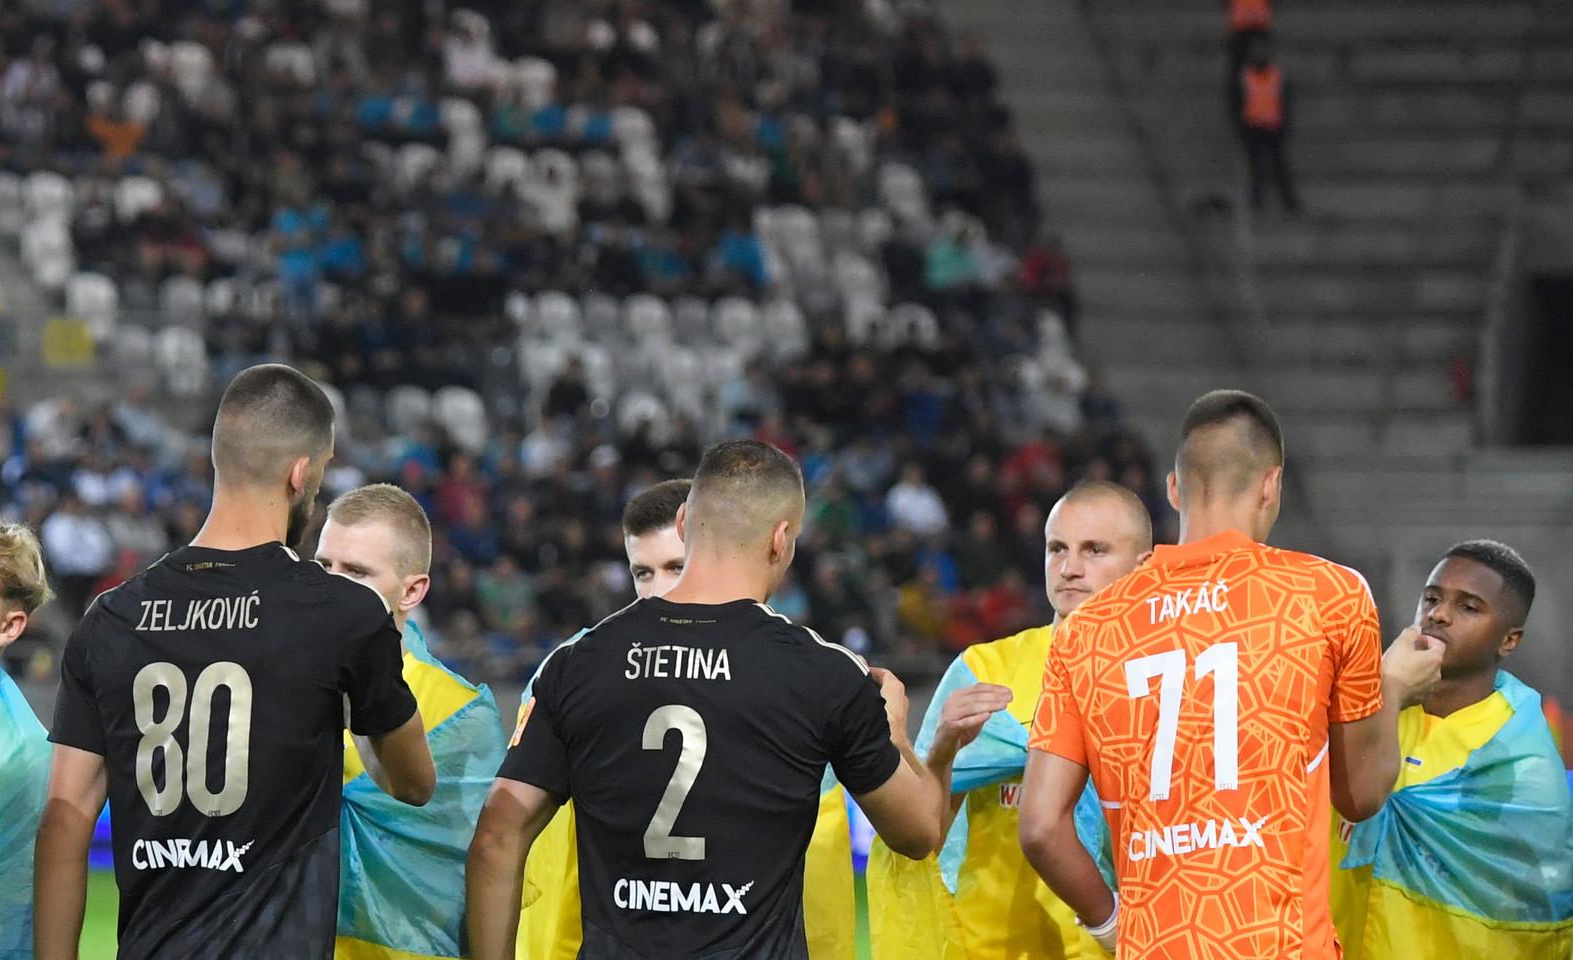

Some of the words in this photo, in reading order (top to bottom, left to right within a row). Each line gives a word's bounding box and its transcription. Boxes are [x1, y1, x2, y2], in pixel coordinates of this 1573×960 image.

[135, 590, 260, 631] ZELJKOVIĆ
[1146, 580, 1229, 624] TAKÁČ
[624, 642, 731, 681] ŠTETINA
[132, 661, 253, 817] 80
[1124, 642, 1239, 802] 71
[642, 704, 708, 861] 2
[1129, 815, 1269, 862] CINEMAX
[613, 878, 754, 914] CINEMAX
